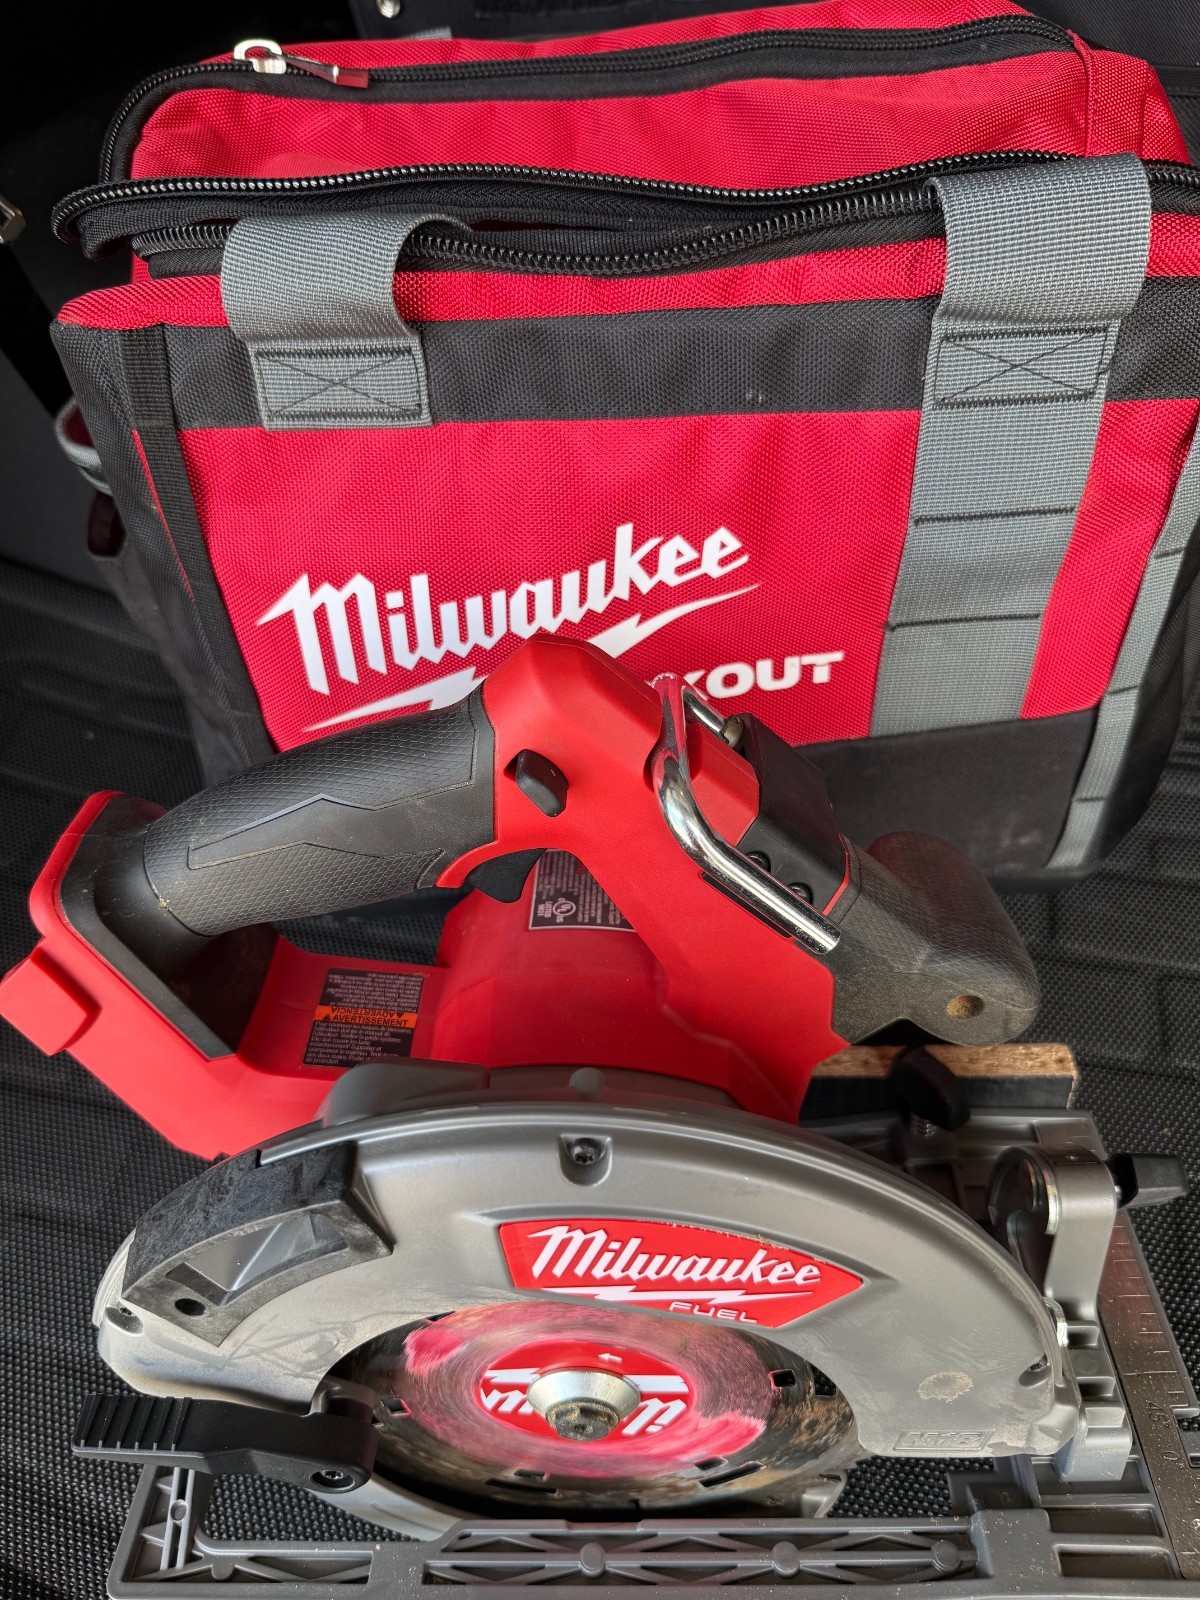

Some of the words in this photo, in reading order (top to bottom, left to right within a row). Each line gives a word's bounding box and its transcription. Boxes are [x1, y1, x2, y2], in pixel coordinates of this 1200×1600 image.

[257, 522, 749, 695] Milwaukee
[331, 1006, 397, 1018] ADVERTENCIA
[333, 1014, 409, 1027] AVERTISSEMENT
[527, 1225, 821, 1285] Milwaukee
[669, 1301, 757, 1323] FUEL
